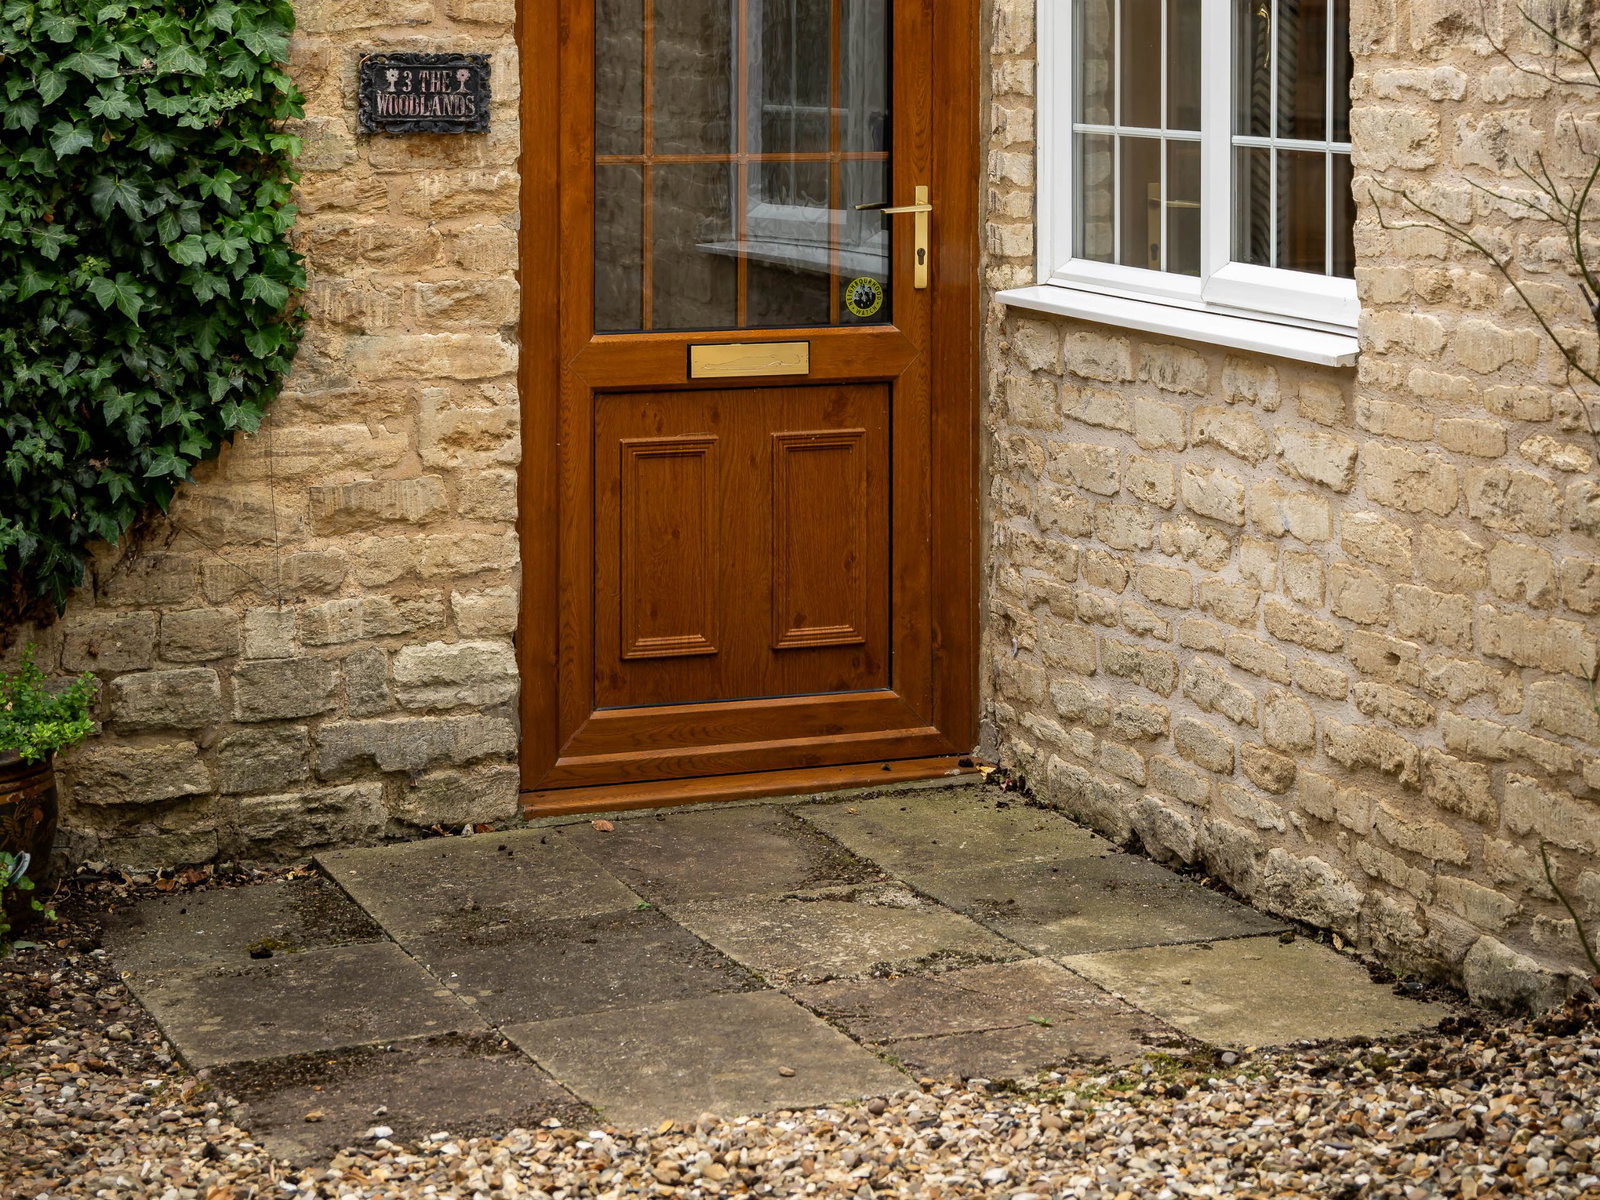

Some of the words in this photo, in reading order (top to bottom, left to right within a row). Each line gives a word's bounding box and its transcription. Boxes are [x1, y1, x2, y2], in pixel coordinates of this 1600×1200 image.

[402, 70, 413, 93] 3
[418, 70, 453, 93] THE
[376, 92, 476, 116] WOODLANDS
[847, 278, 882, 306] NEIGHBOURHOOD
[855, 305, 877, 315] WATCH
